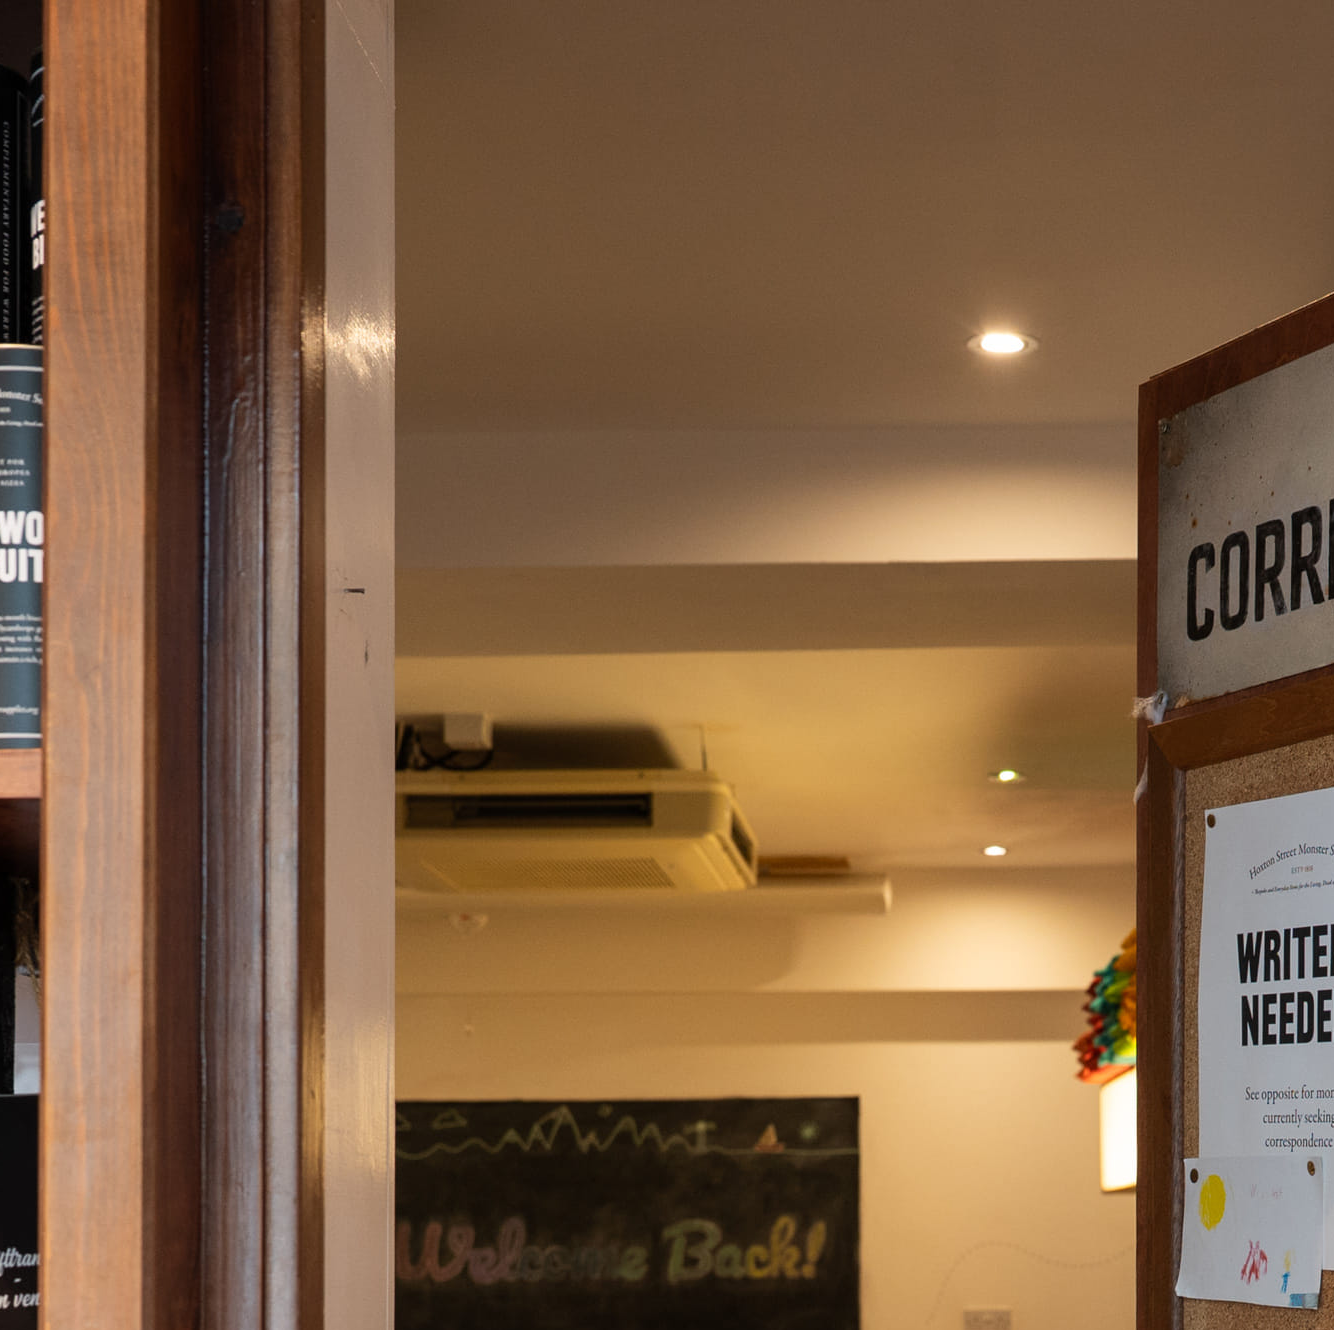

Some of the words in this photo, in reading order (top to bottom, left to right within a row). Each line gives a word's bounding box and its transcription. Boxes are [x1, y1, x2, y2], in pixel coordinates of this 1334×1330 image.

[1249, 856, 1275, 880] Hoxton
[1276, 848, 1297, 864] Street
[1299, 843, 1329, 855] Monster
[1245, 1086, 1260, 1100] See
[1261, 1086, 1299, 1104] opposite
[1301, 1084, 1315, 1098] for
[1263, 1110, 1302, 1128] currently
[1265, 1134, 1333, 1152] correspondence
[396, 1216, 649, 1284] Welcome
[662, 1215, 826, 1285] Back!
